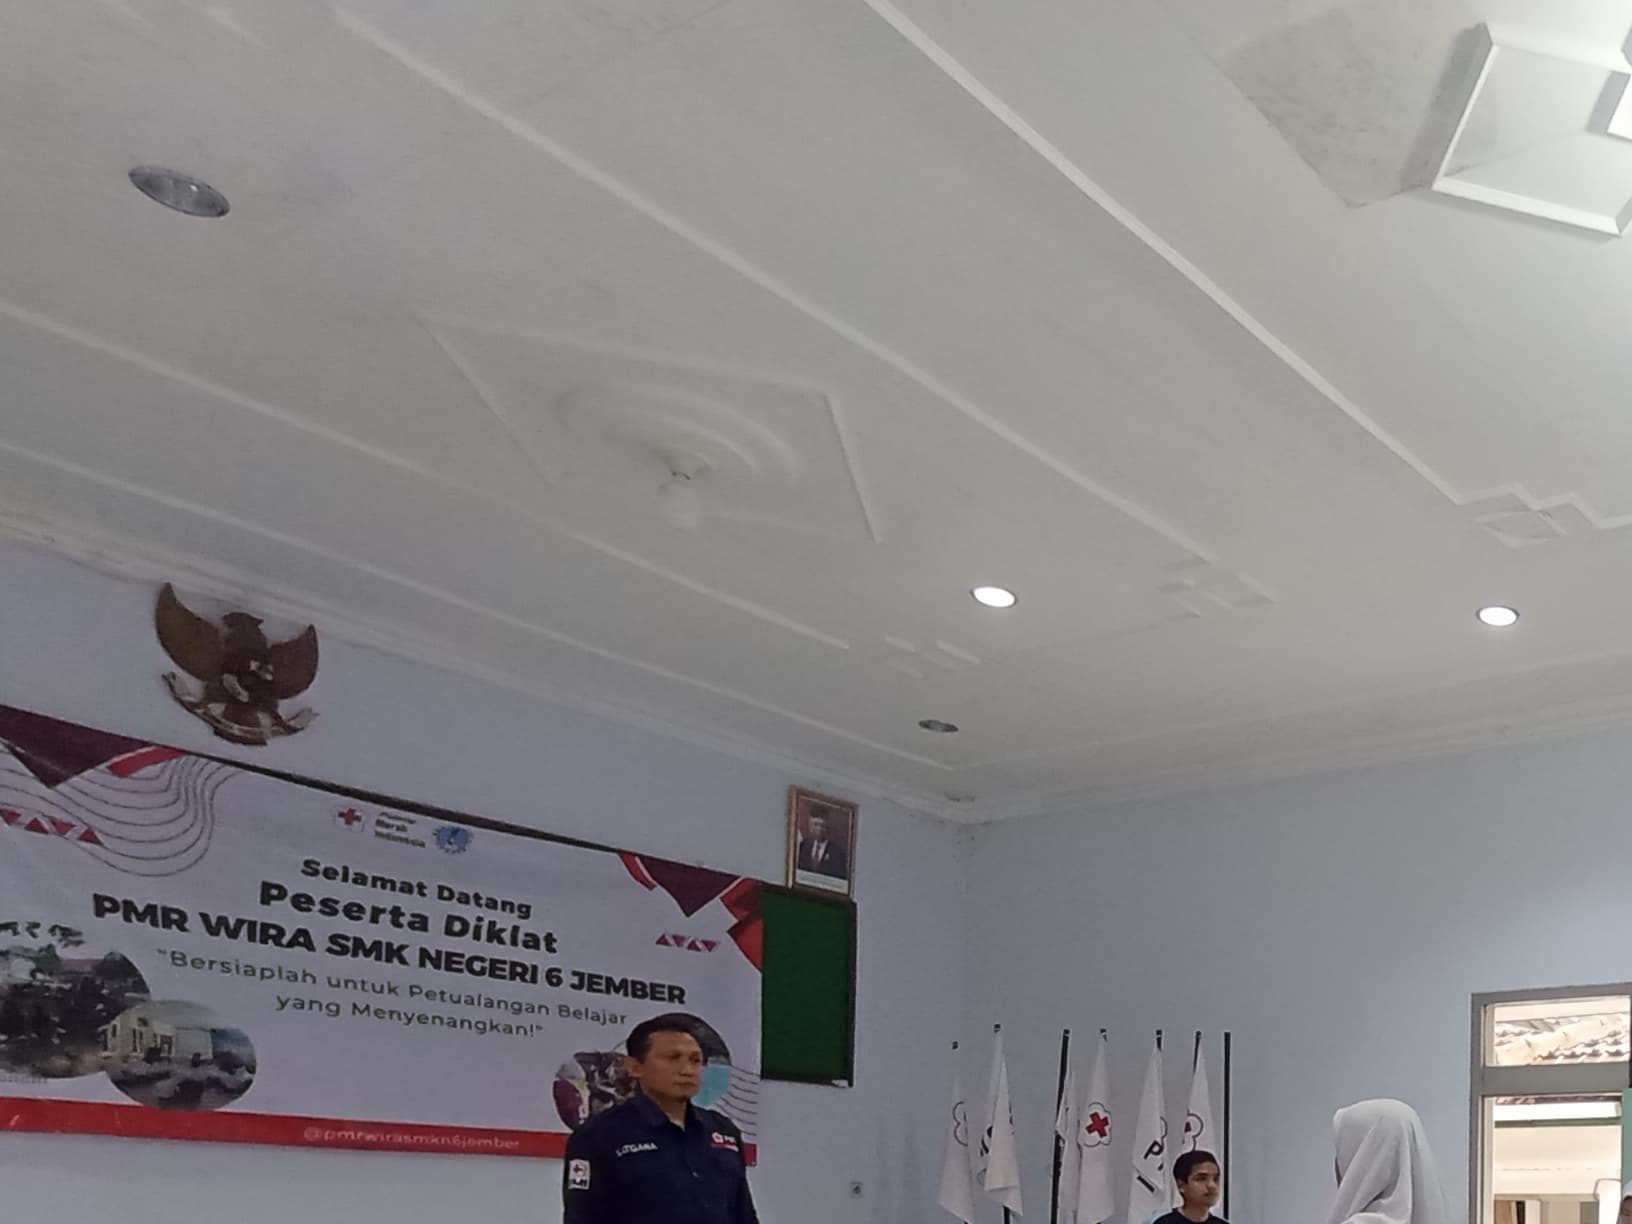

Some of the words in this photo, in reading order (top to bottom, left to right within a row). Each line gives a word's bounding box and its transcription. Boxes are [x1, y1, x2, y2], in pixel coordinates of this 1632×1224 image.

[259, 880, 430, 933] Peserta
[444, 914, 558, 954] Diklat
[301, 858, 428, 898] Selamat
[436, 884, 532, 920] Datang
[92, 893, 190, 933] PMR
[199, 911, 316, 953] WIRA
[325, 933, 410, 967] SMK
[418, 947, 539, 985] NEGERI
[545, 967, 564, 988] 6
[569, 970, 686, 1005] JEMBER
[275, 995, 341, 1018] yang
[326, 975, 400, 998] untuk
[408, 984, 550, 1016] Petualangan
[558, 1004, 628, 1027] Belajar
